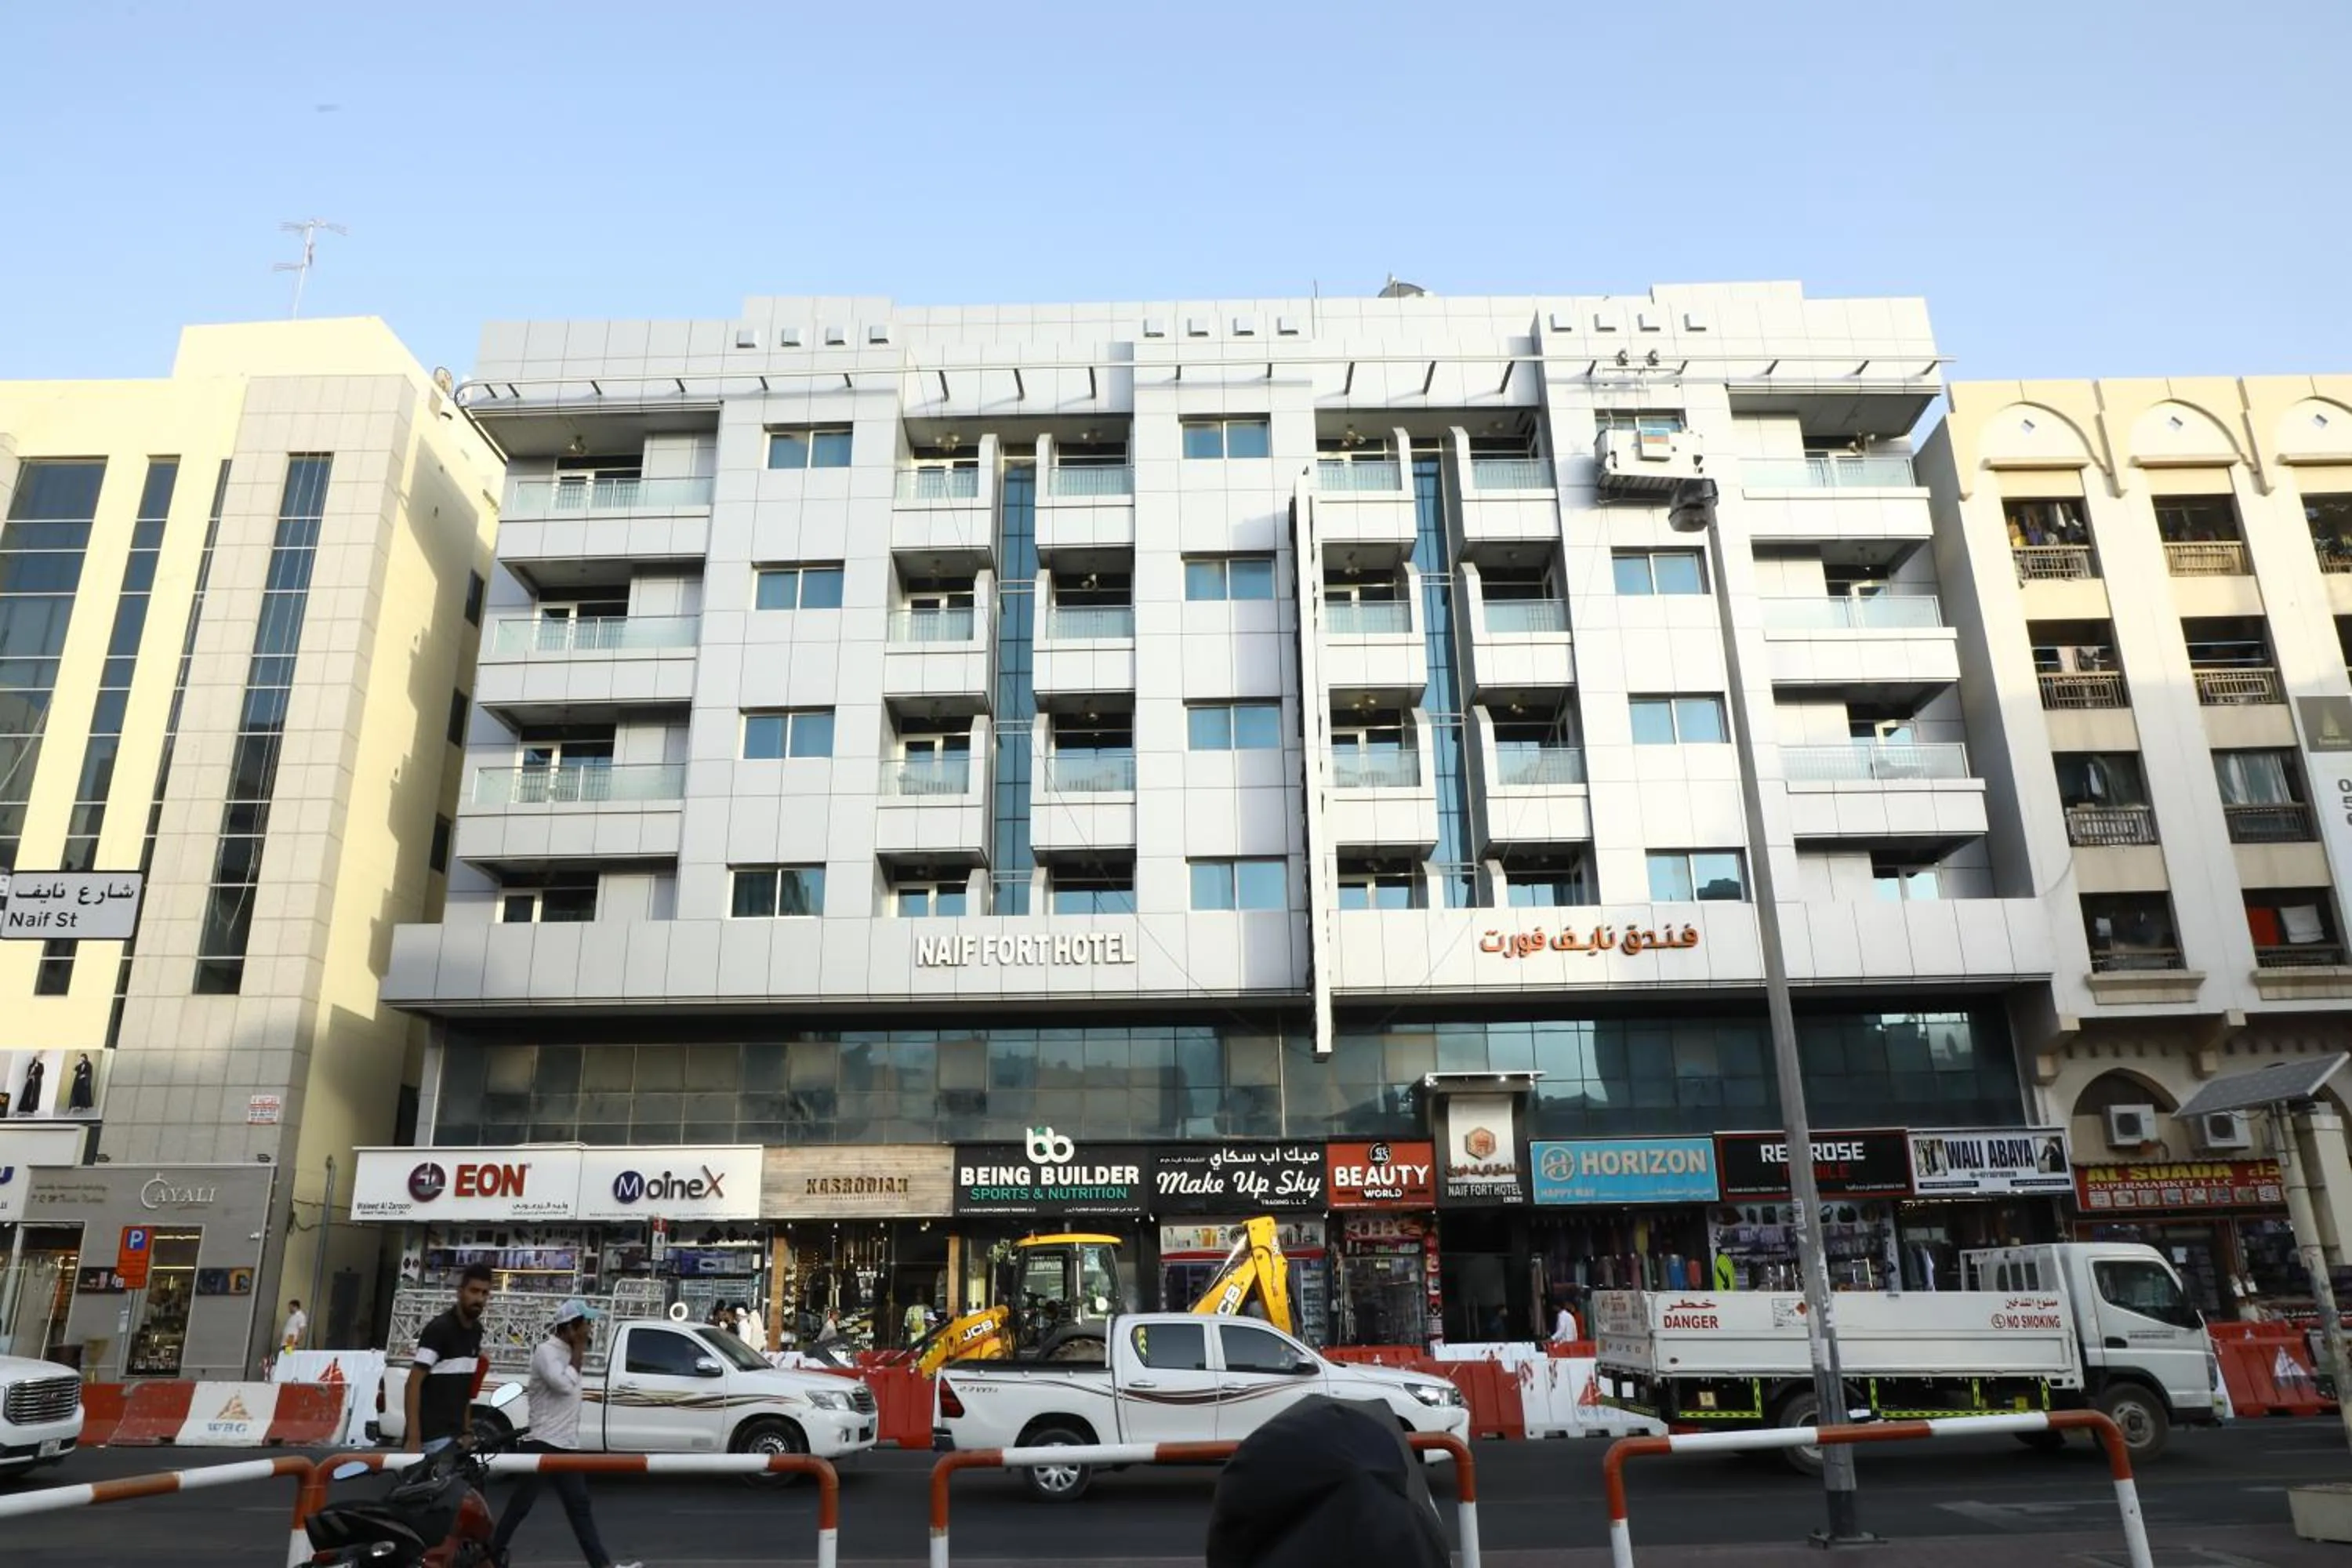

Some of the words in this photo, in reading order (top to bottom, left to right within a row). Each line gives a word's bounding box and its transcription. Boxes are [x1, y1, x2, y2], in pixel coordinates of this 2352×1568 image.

[15, 881, 66, 903] نايف
[78, 881, 134, 905] شارع
[9, 912, 51, 927] Naif
[55, 912, 78, 927] St
[916, 935, 976, 967] NAIF
[981, 933, 1050, 966] FORT
[1052, 932, 1136, 964] HOTEL
[1479, 926, 1546, 959] فورت
[1550, 924, 1616, 956] نايف
[1621, 923, 1699, 956] فندق
[1210, 1147, 1257, 1171] سكاي
[1260, 1147, 1281, 1166] اب
[1283, 1147, 1320, 1165] ميك
[1580, 1149, 1708, 1175] HORIZON
[1760, 1144, 1789, 1163] RE
[1945, 1140, 1984, 1169] WALI
[1987, 1139, 2036, 1168] ABAYA
[454, 1163, 527, 1197] EON
[960, 1167, 1032, 1186] BEING
[1040, 1166, 1140, 1185] BUILDER
[1156, 1171, 1225, 1194] Make
[1232, 1171, 1270, 1200] Up
[1275, 1170, 1321, 1198] Sky
[1334, 1164, 1429, 1186] BEAUTY
[2087, 1167, 2122, 1182] AL
[2088, 1180, 2195, 1191] SUPERMARKET
[970, 1187, 1029, 1201] SPORTS
[1032, 1187, 1044, 1200] &
[1048, 1186, 1128, 1200] NUTRITION
[1363, 1188, 1403, 1199] WORLD
[1447, 1184, 1468, 1196] NAIF
[1470, 1183, 1494, 1196] FORT
[1494, 1182, 1523, 1196] HOTEL
[1216, 1284, 1242, 1316] CB
[1666, 1298, 1717, 1312] خطر
[962, 1319, 993, 1341] JCB
[1664, 1315, 1719, 1330] DANGER
[2006, 1315, 2020, 1329] NO
[2022, 1315, 2062, 1329] SMOKING
